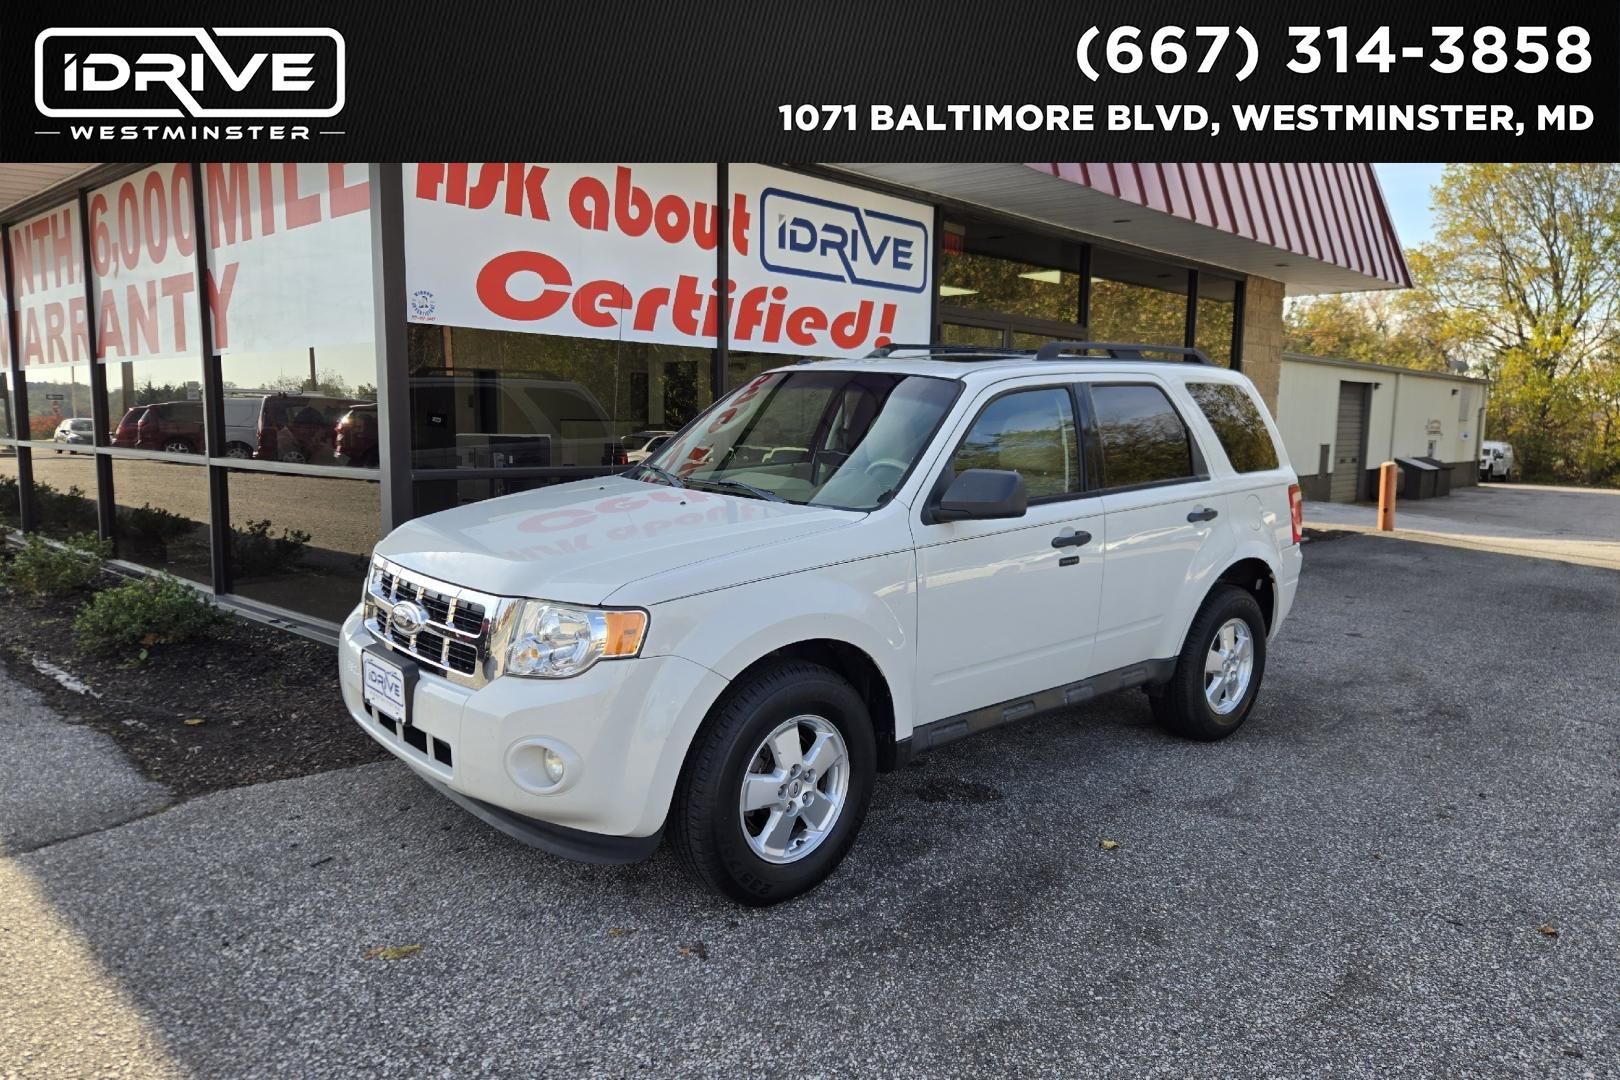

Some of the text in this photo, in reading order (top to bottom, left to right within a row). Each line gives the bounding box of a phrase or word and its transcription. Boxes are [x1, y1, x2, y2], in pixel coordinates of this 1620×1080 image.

[90, 163, 196, 279] 6,000
[569, 166, 750, 256] about
[476, 250, 897, 350] Certified!
